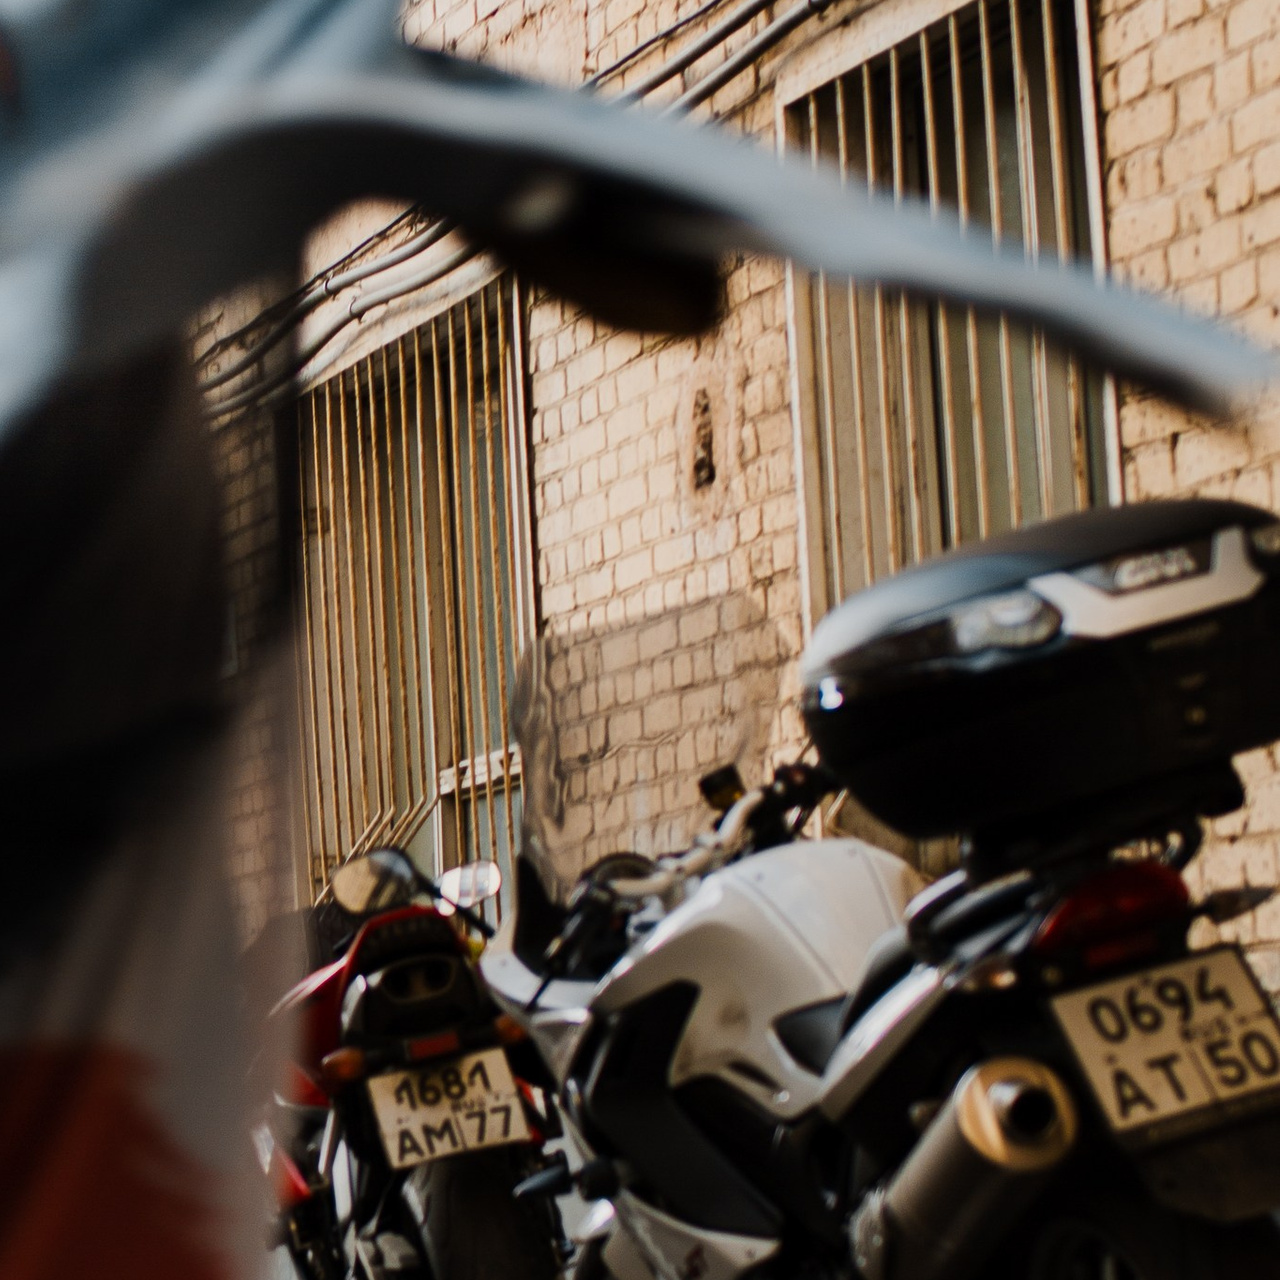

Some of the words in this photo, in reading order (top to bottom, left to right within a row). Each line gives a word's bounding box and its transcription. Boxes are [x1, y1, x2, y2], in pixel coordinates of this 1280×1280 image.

[1087, 966, 1235, 1045] 0694
[394, 1060, 491, 1112] 1681
[1204, 1030, 1280, 1088] 50
[464, 1104, 511, 1143] 77
